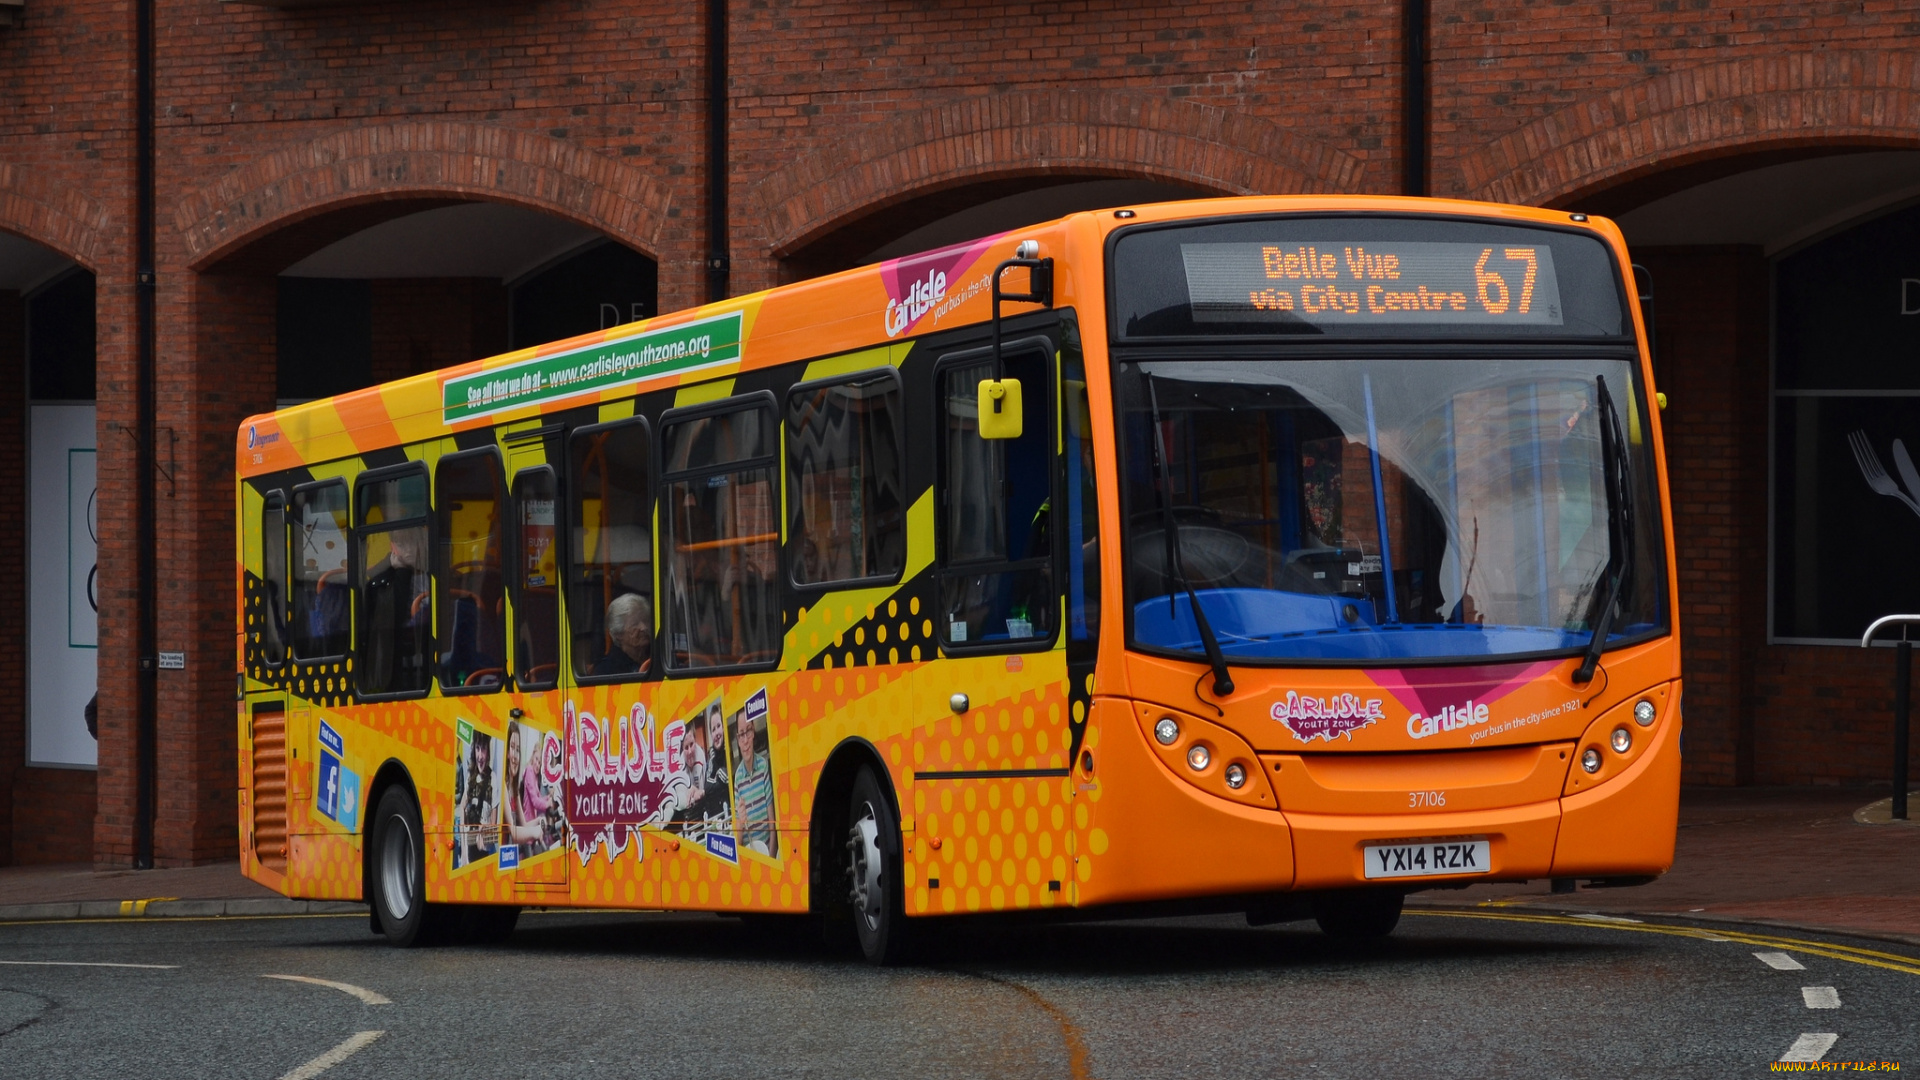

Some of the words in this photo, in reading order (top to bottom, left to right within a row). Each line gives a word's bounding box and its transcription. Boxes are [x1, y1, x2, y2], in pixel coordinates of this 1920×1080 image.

[1262, 246, 1337, 279] Belle
[1345, 247, 1401, 279] Vue
[1474, 248, 1538, 314] 67
[884, 268, 947, 338] Carlisle
[933, 301, 949, 326] your
[949, 294, 961, 311] bus
[967, 281, 979, 298] the
[1249, 289, 1294, 311] via
[1301, 285, 1359, 314] City
[1366, 286, 1467, 314] Centre
[467, 386, 482, 409] See
[482, 381, 493, 405] all
[493, 378, 508, 403] that
[509, 377, 520, 399] we
[521, 372, 532, 396] do
[532, 370, 541, 393] at
[549, 334, 710, 389] www.carlisleyouthzone.org
[747, 697, 765, 715] Cooking
[1270, 691, 1384, 720] CARLISLE
[1406, 700, 1489, 740] Carlisle
[1298, 720, 1329, 730] YOUTH
[1332, 719, 1355, 729] ZONE
[1469, 729, 1488, 744] your
[1489, 725, 1504, 736] bus
[1504, 720, 1512, 731] in
[1512, 717, 1526, 729] the
[1526, 713, 1541, 725] city
[1541, 706, 1561, 720] since
[1562, 699, 1580, 713] 1921
[541, 700, 686, 784] CARLISLE
[574, 791, 615, 818] YOUTH
[618, 793, 649, 814] ZONE
[1408, 791, 1446, 808] 37106
[710, 836, 719, 851] Fun
[718, 840, 734, 858] Games
[1378, 845, 1427, 873] YX14
[1433, 844, 1476, 870] RZK
